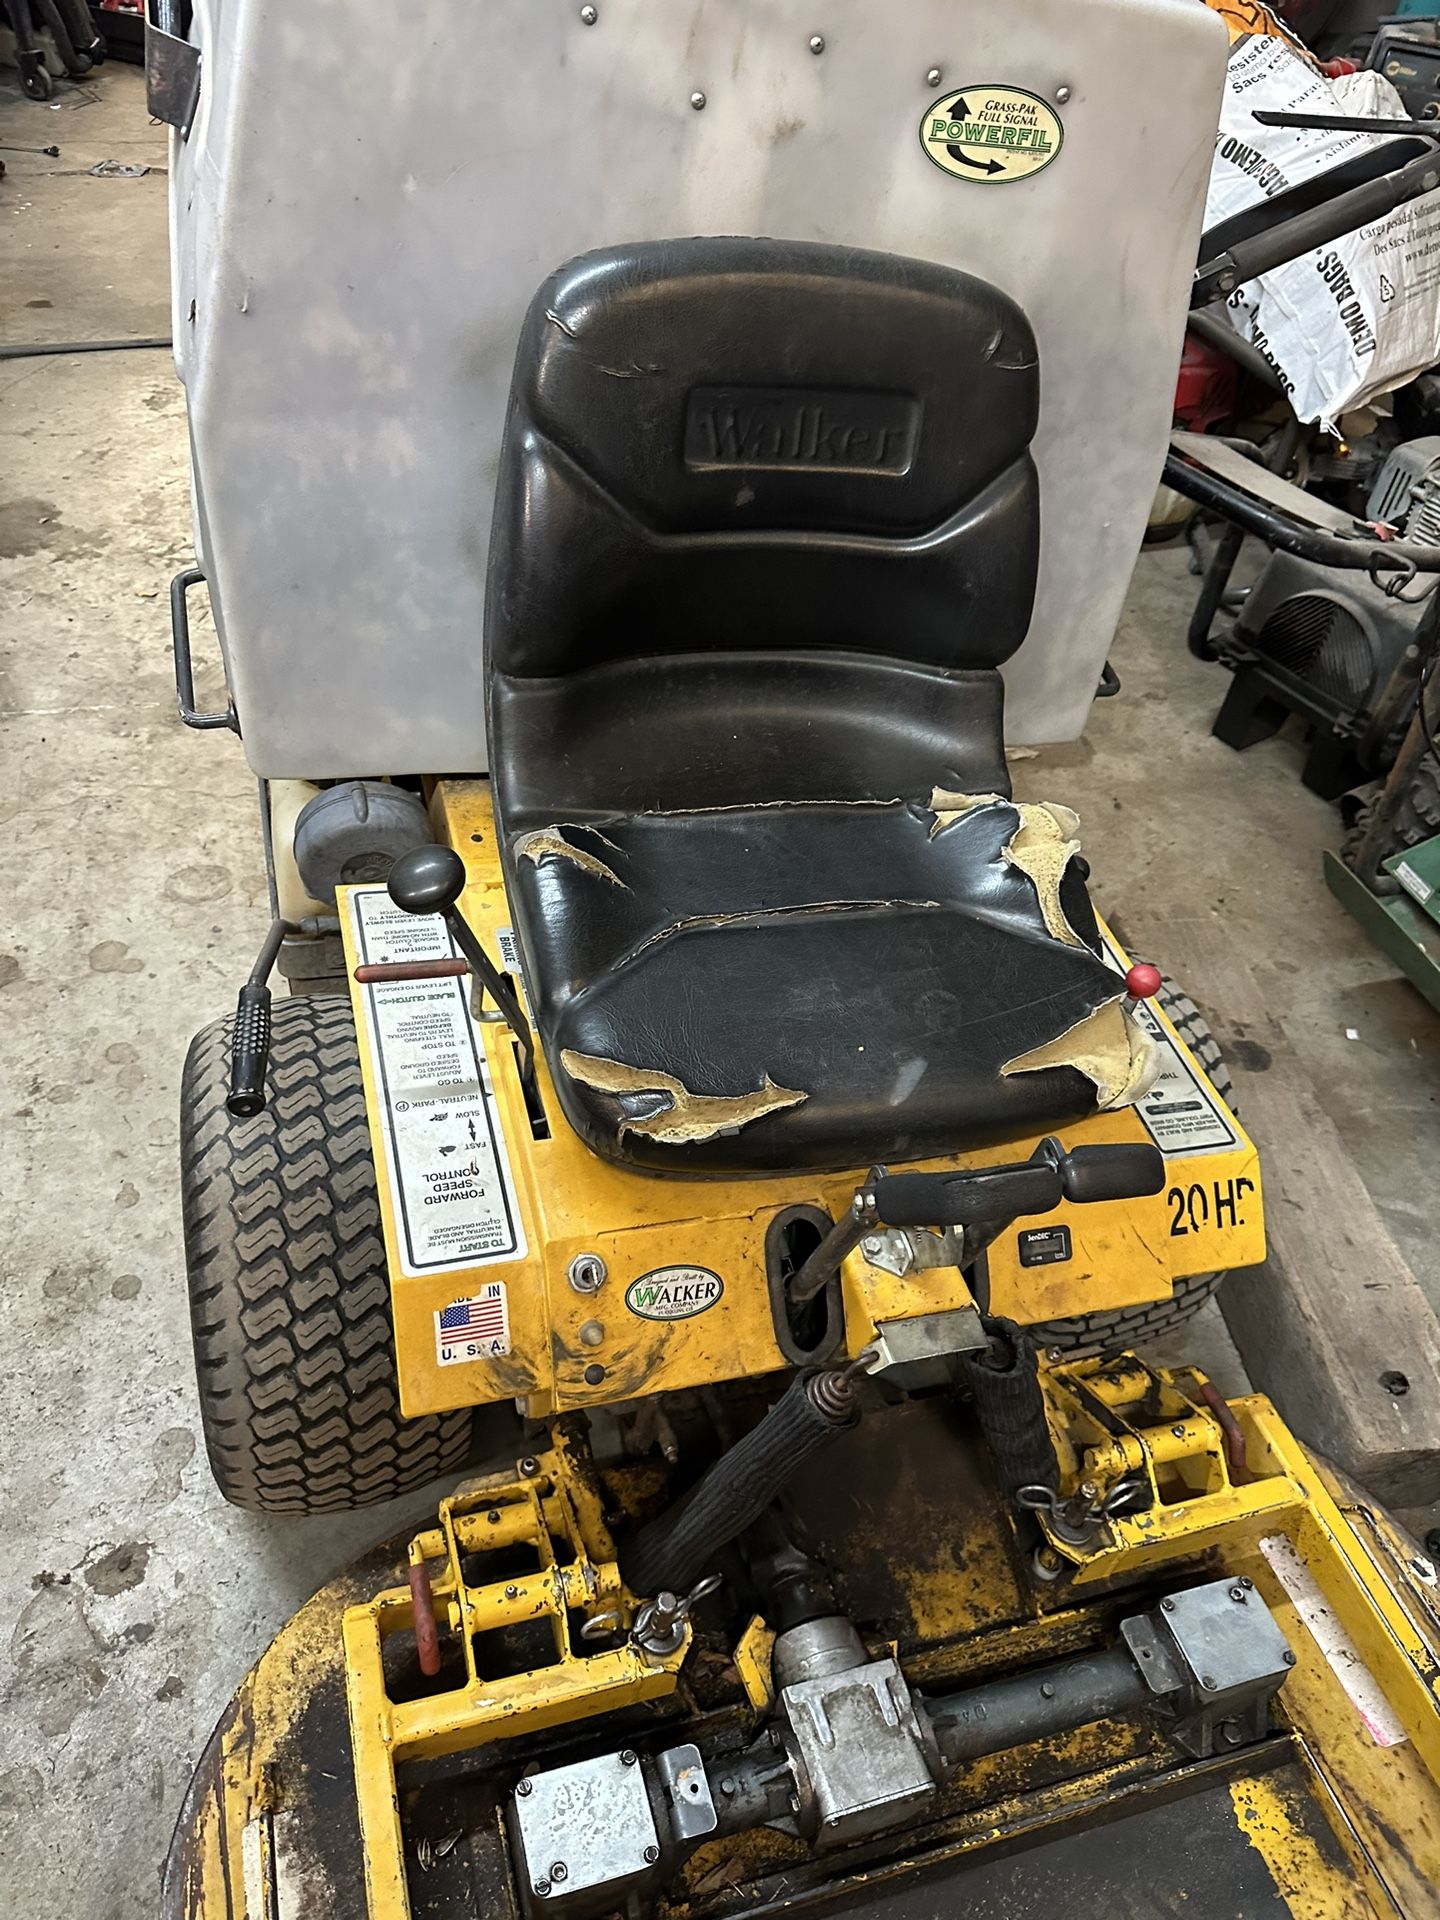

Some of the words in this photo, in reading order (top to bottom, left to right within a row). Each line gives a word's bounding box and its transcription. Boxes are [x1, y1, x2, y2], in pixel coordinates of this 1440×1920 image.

[1232, 72, 1267, 94] Sacs
[985, 100, 1038, 115] GRASS-PAK
[978, 111, 1001, 122] FULL
[1003, 114, 1038, 126] SIGNAL
[931, 119, 1052, 148] POWERFIL
[1317, 252, 1355, 305] BAGS
[1340, 302, 1376, 357] DEMO
[695, 406, 903, 461] Walker
[500, 936, 516, 963] BRAKE
[391, 995, 425, 1003] CLUTCH
[428, 992, 455, 1000] BLADE
[456, 1110, 480, 1118] SLOW
[465, 1142, 486, 1150] FAST
[433, 1180, 472, 1192] SPEED
[424, 1189, 485, 1205] FORWARD
[1168, 1184, 1208, 1236] 20
[434, 1223, 474, 1234] DISENGAGED
[476, 1218, 501, 1226] CLUTCH
[456, 1231, 502, 1242] TRANSMISSION
[466, 1226, 495, 1234] NEUTRAL
[428, 1233, 449, 1241] BLADE
[459, 1241, 489, 1252] START
[488, 1284, 500, 1297] IN
[635, 1282, 716, 1307] WALKER
[671, 1301, 699, 1309] COMPANY
[442, 1348, 456, 1360] U.
[467, 1344, 480, 1355] S.
[491, 1340, 504, 1352] A.
